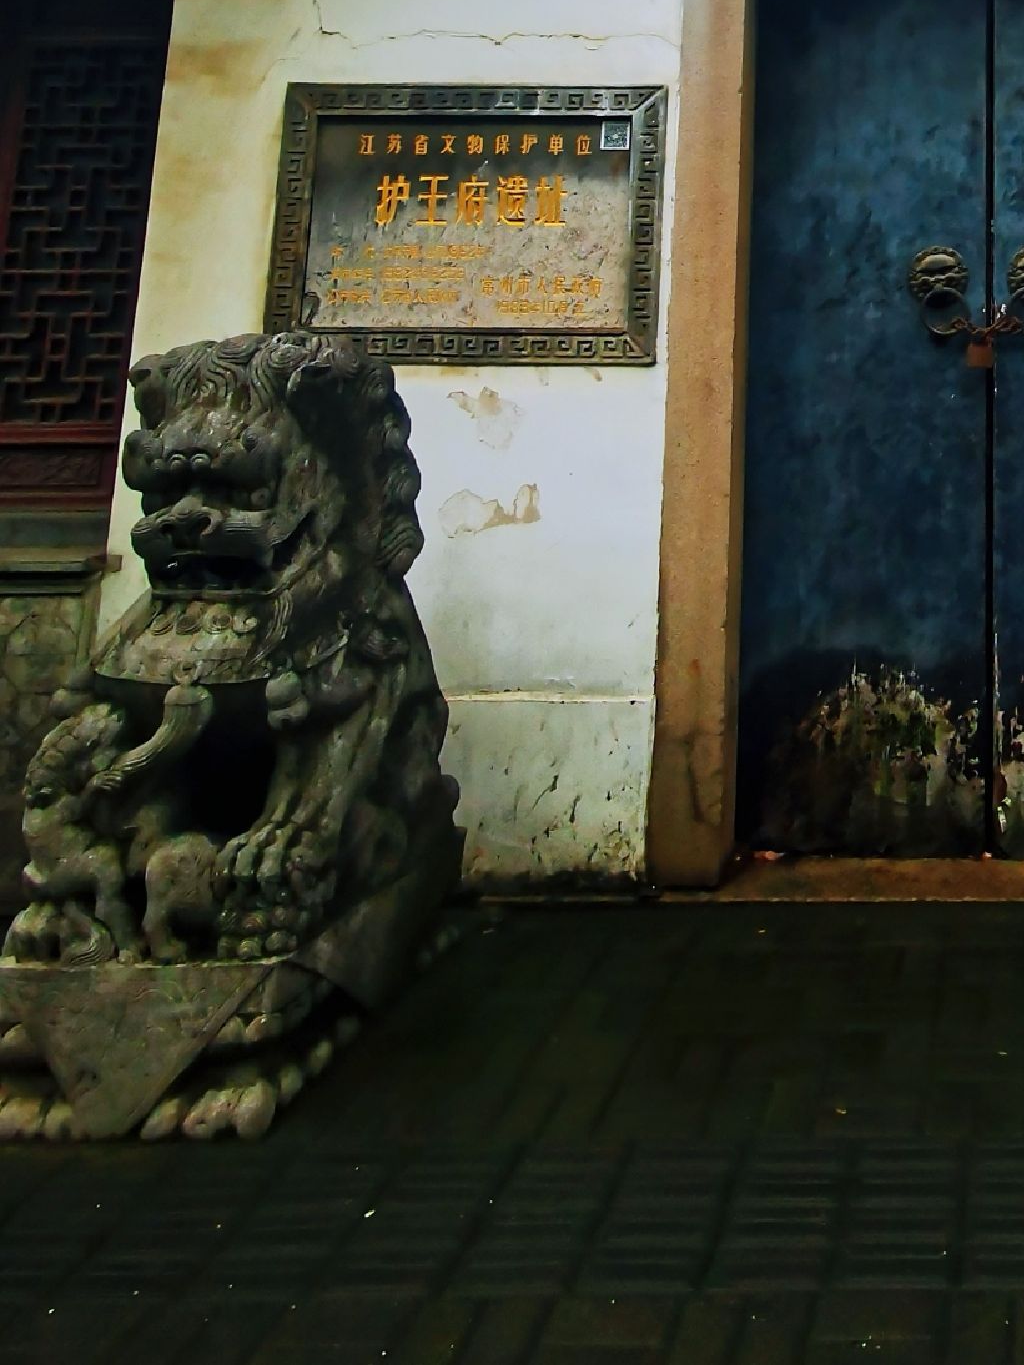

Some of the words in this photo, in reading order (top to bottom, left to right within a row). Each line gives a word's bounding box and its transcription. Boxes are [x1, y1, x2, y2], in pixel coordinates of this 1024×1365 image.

[358, 133, 593, 155] 江苏省文物保护单位
[374, 175, 568, 227] 护王府遗址
